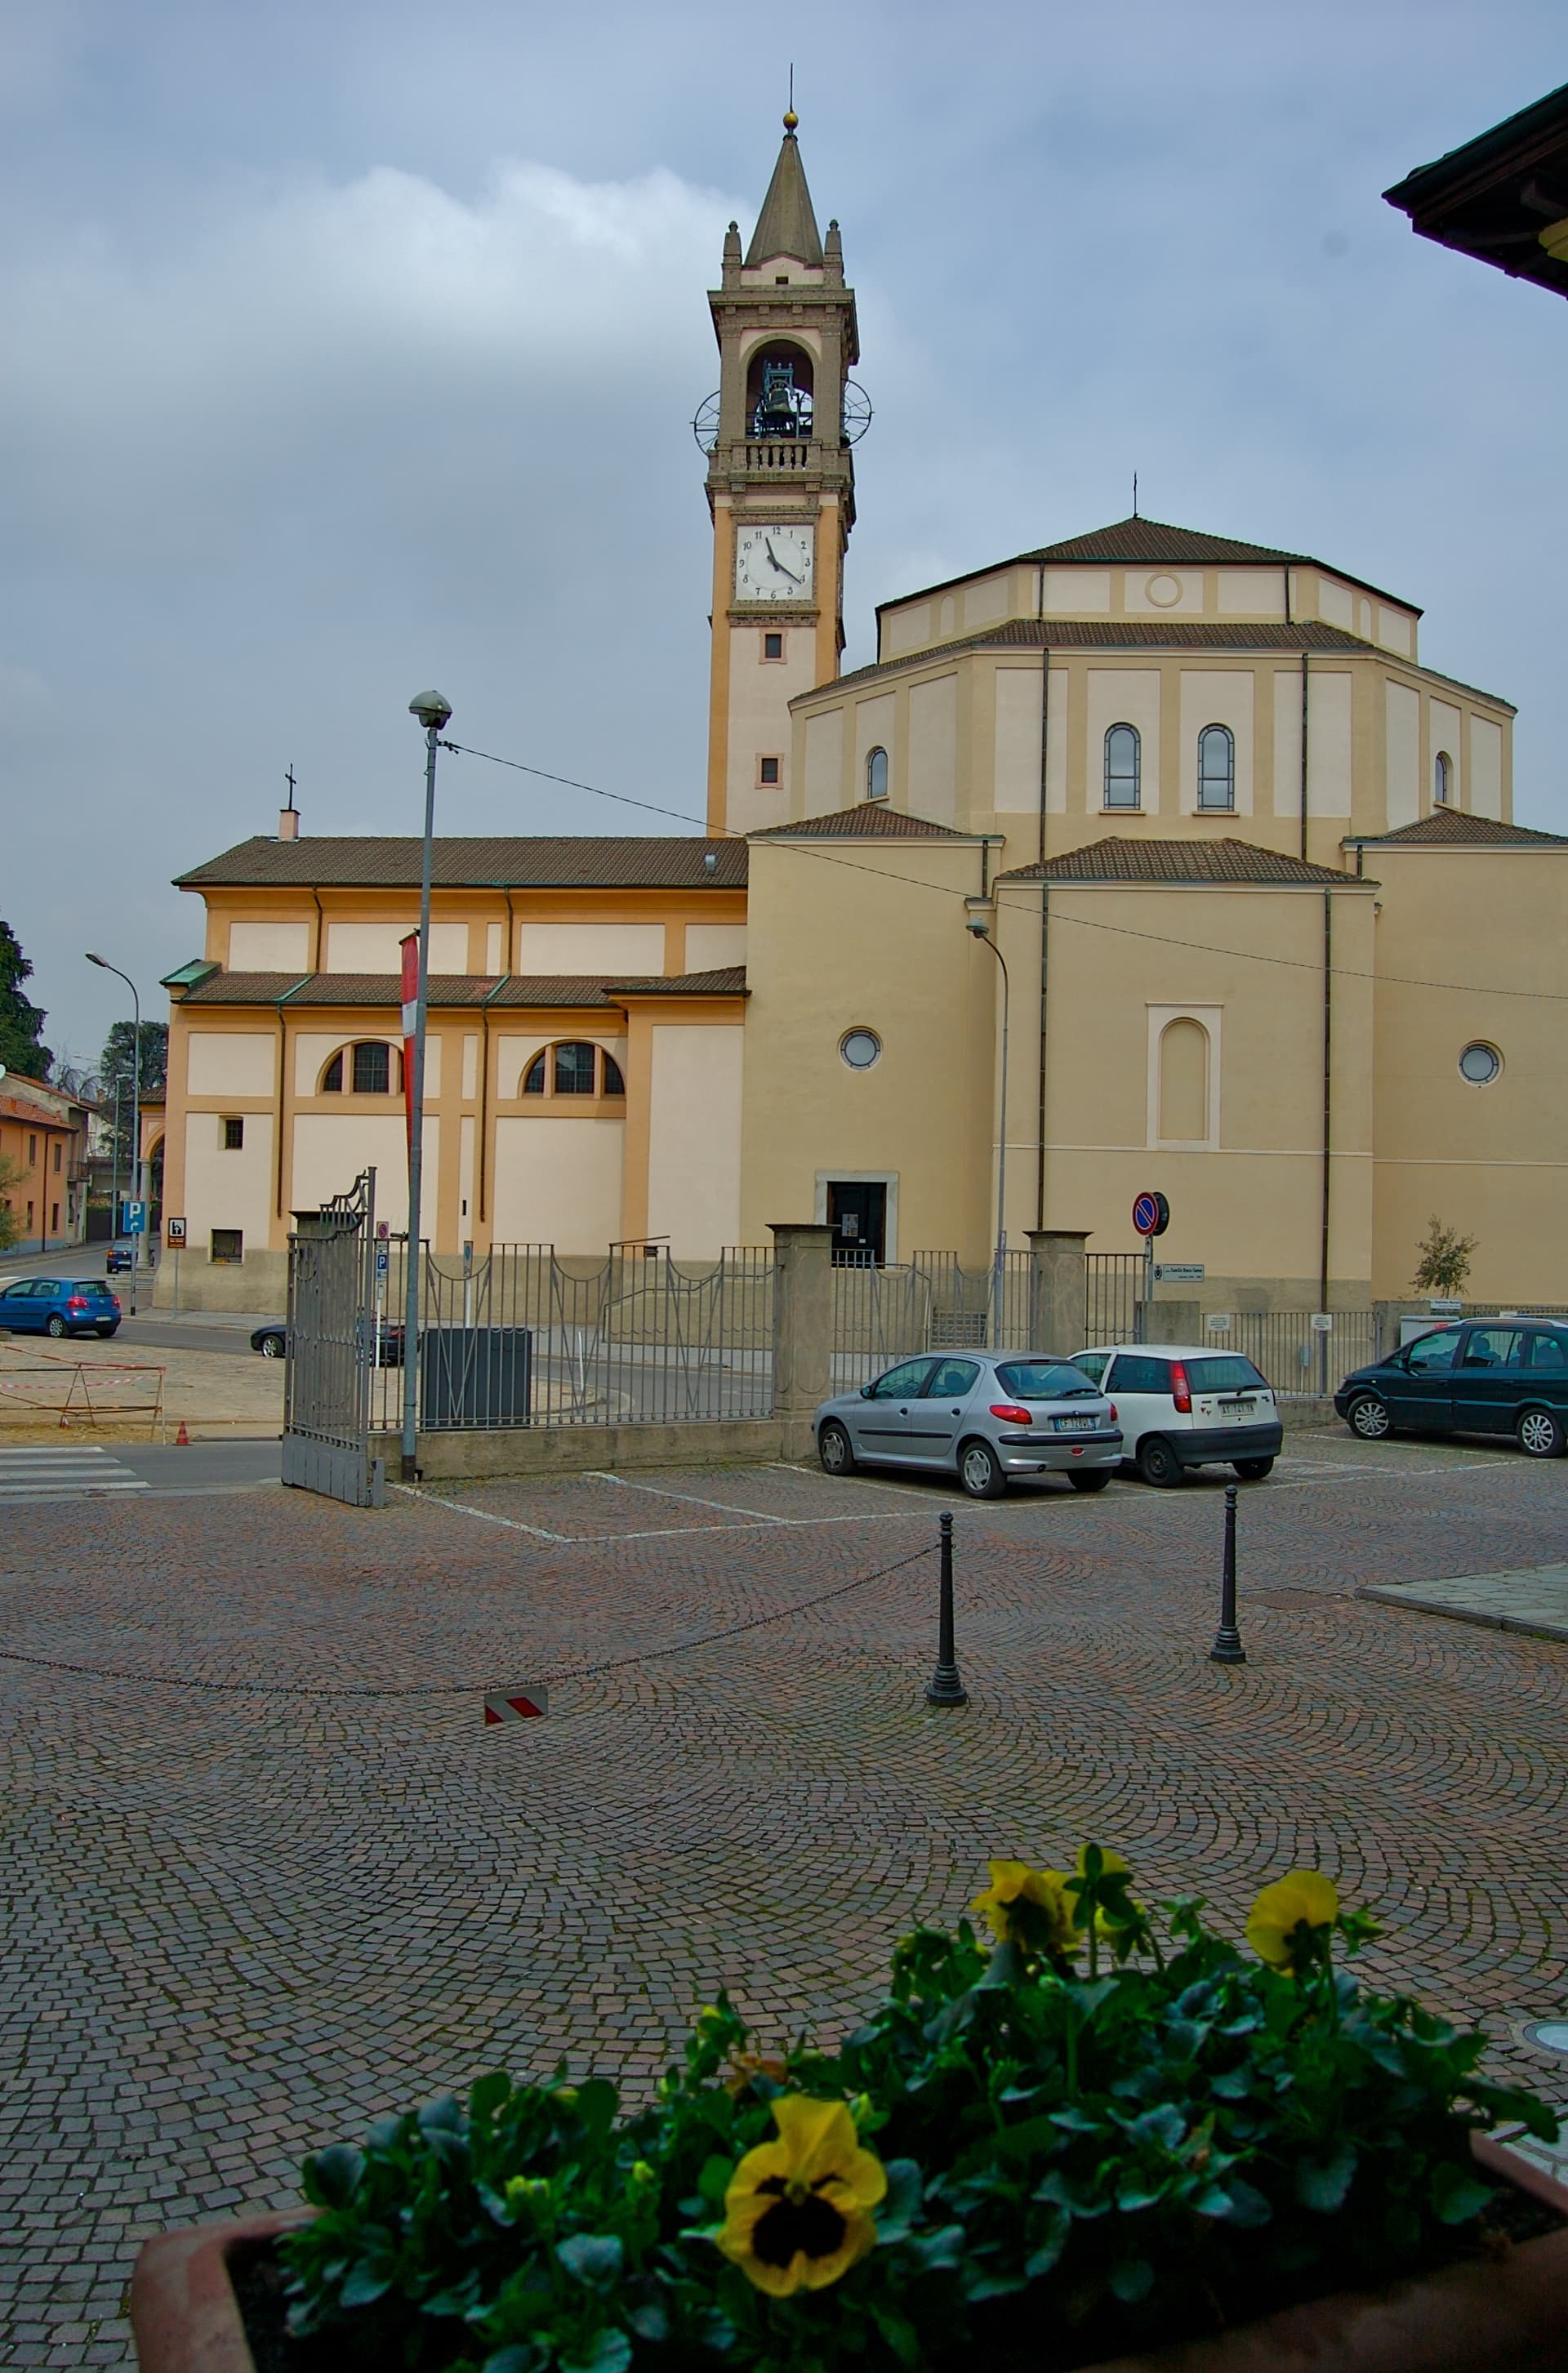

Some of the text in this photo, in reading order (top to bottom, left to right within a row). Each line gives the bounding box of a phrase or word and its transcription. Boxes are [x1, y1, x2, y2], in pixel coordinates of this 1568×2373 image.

[755, 531, 763, 539] 11
[773, 526, 782, 535] 12
[789, 529, 793, 539] 1
[743, 541, 751, 550] 10
[800, 541, 806, 550] 2
[739, 559, 745, 568] 9
[804, 558, 811, 567] 3
[742, 574, 749, 583] 8
[770, 590, 777, 599] 6
[787, 586, 793, 594] 5
[130, 1202, 141, 1219] P
[379, 1256, 385, 1268] P
